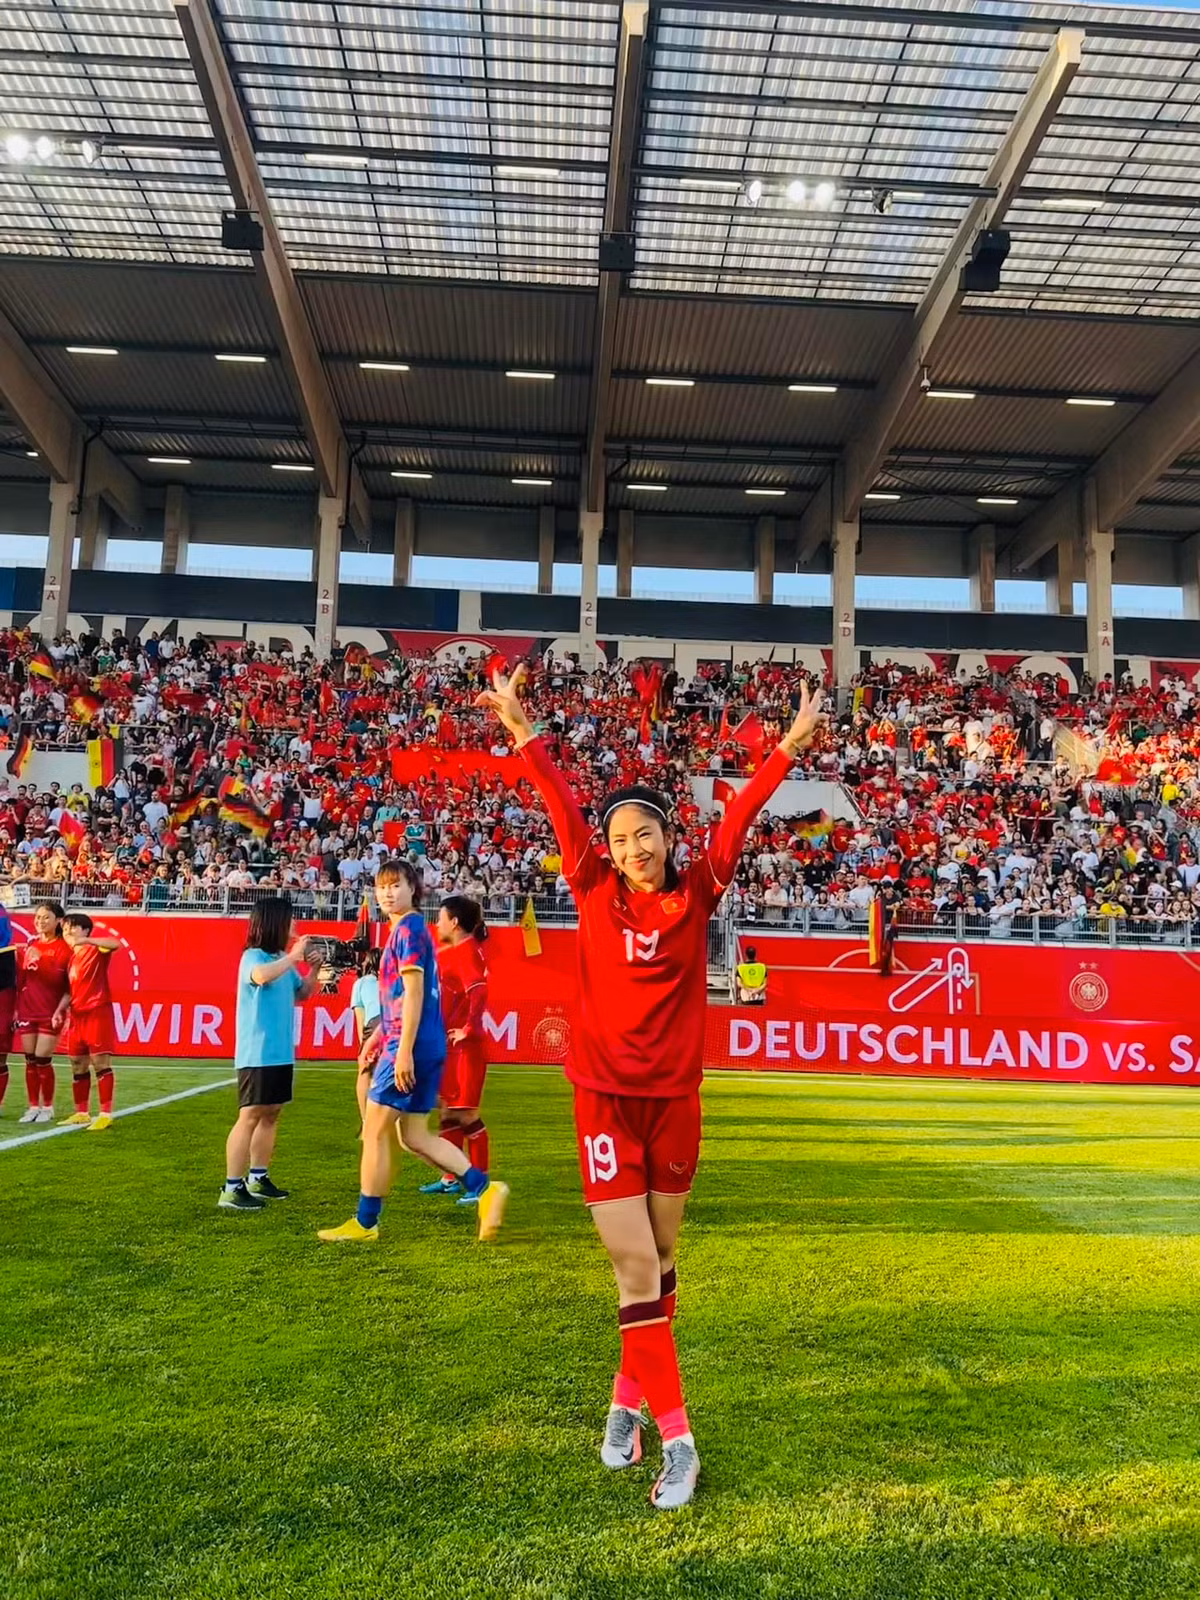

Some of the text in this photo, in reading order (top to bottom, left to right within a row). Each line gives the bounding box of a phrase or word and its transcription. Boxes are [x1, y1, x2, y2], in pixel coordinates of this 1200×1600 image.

[47, 576, 57, 600] 2 A
[321, 589, 330, 614] 2 B
[584, 602, 593, 627] 2 C
[842, 612, 851, 637] 2 D
[1101, 636, 1110, 646] A
[622, 928, 659, 962] 19
[112, 1002, 223, 1045] WIR
[729, 1019, 1088, 1069] DEUTSCHLAND
[1169, 1034, 1200, 1074] S
[584, 1133, 618, 1184] 19
